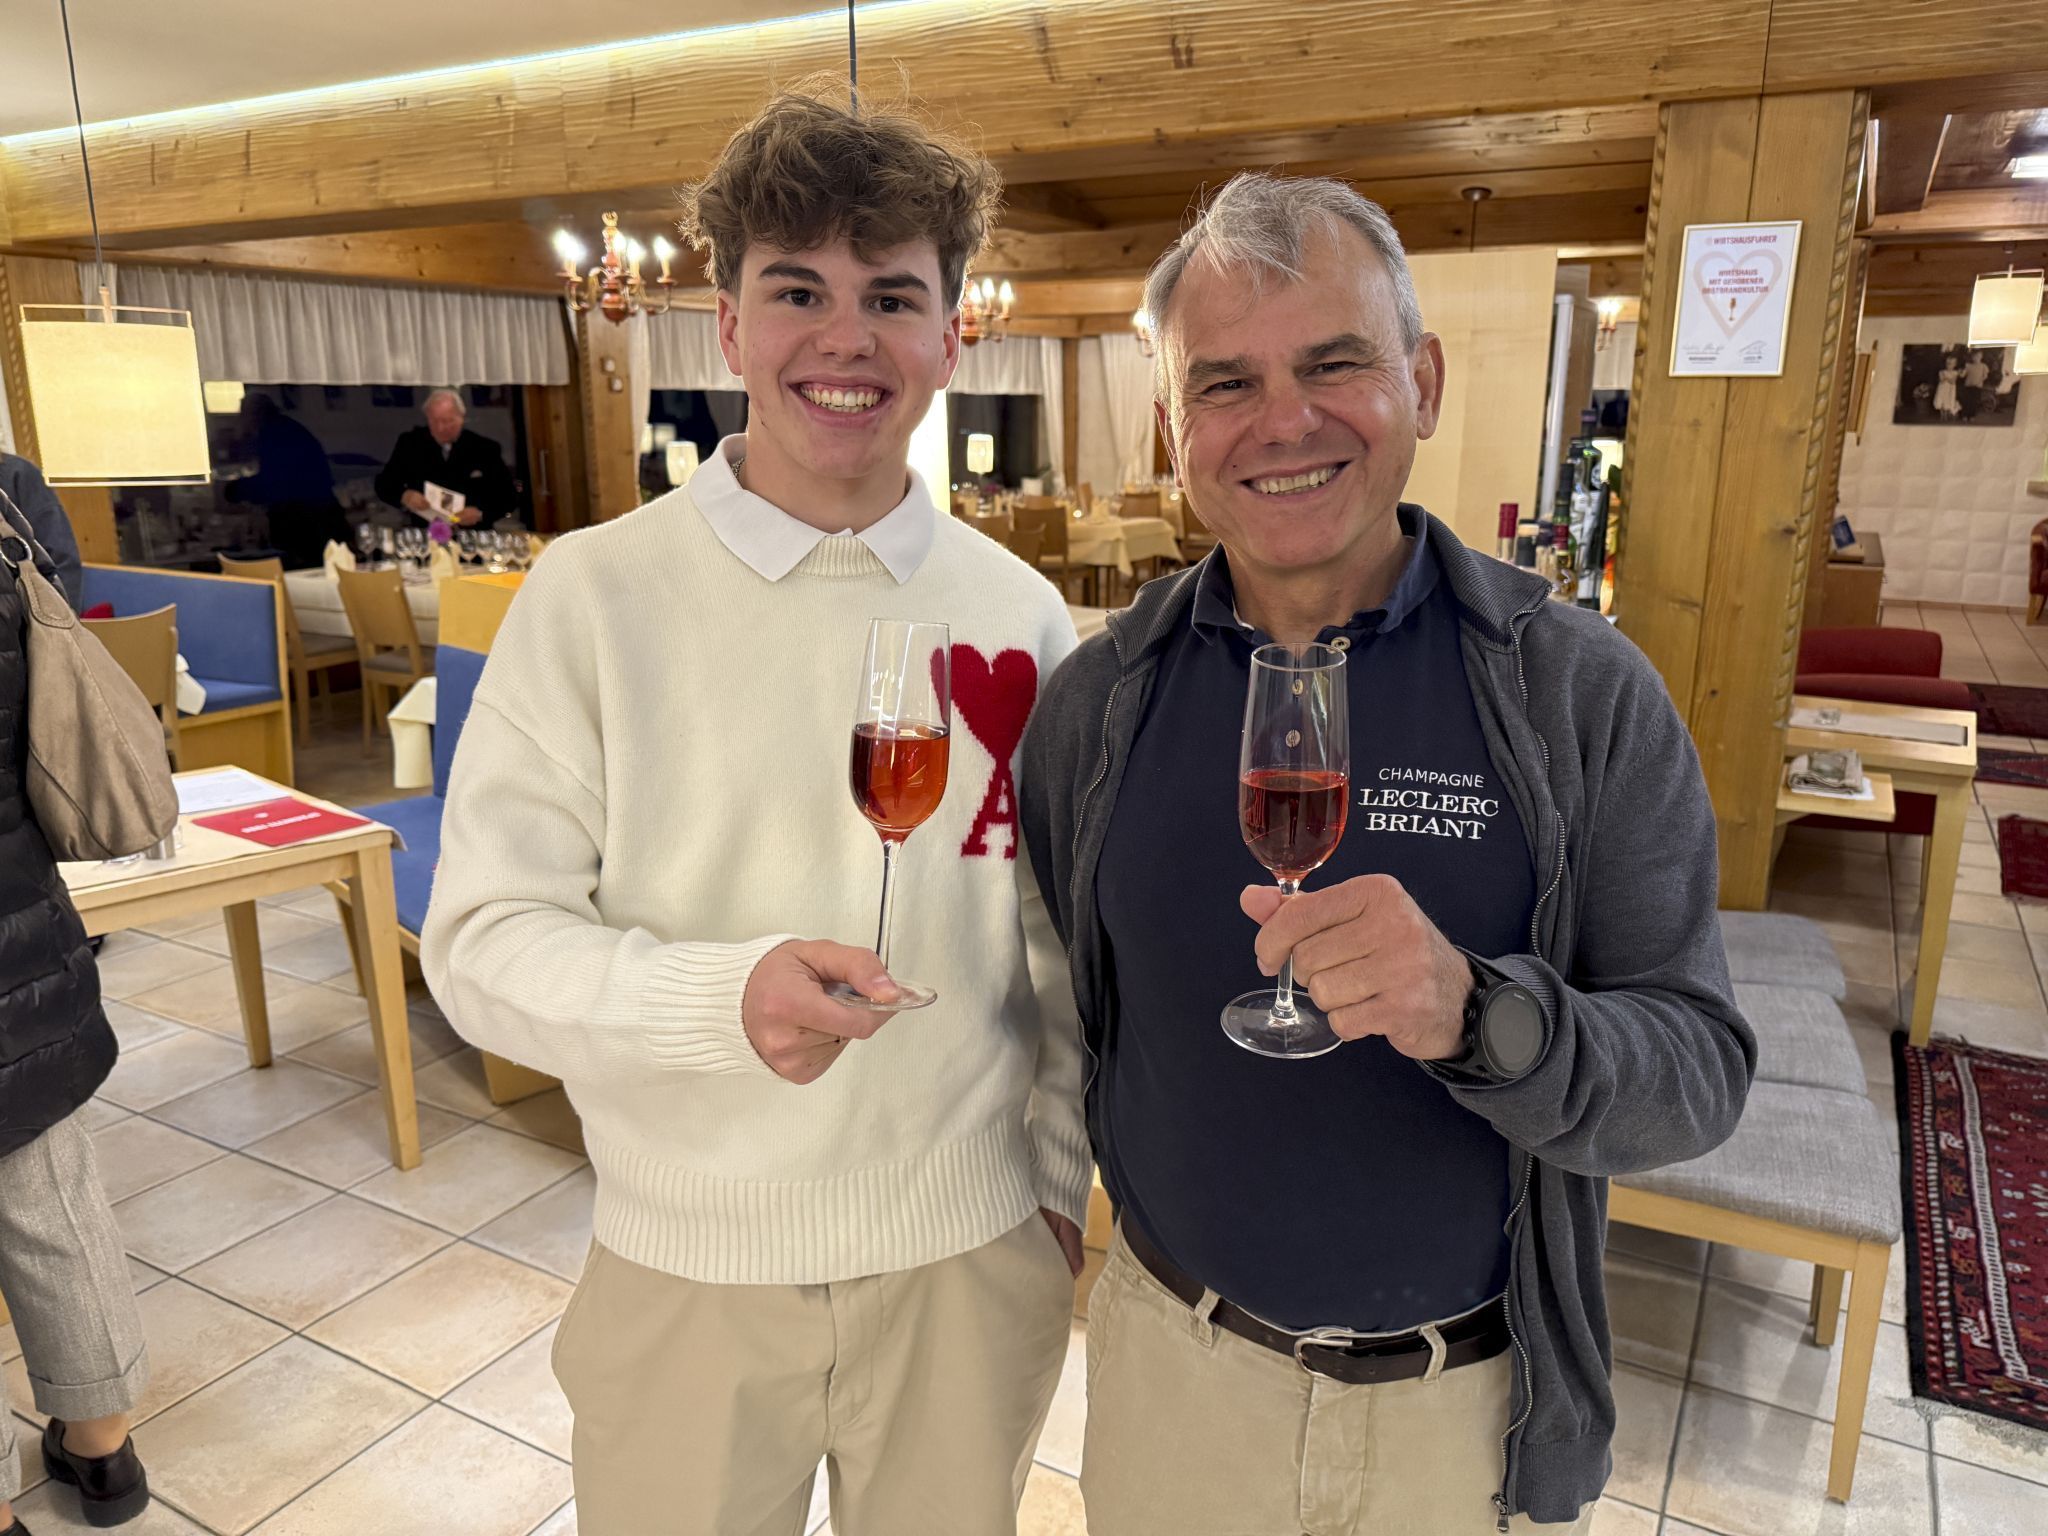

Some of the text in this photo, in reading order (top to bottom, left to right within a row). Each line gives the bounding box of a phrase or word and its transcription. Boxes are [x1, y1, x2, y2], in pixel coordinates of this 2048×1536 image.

[1718, 269, 1758, 277] WIRTSHAUS
[1379, 768, 1485, 788] CHAMPAGNE
[961, 758, 1019, 859] A
[1358, 788, 1499, 817] LECLERC
[1365, 812, 1486, 840] BRIANT
